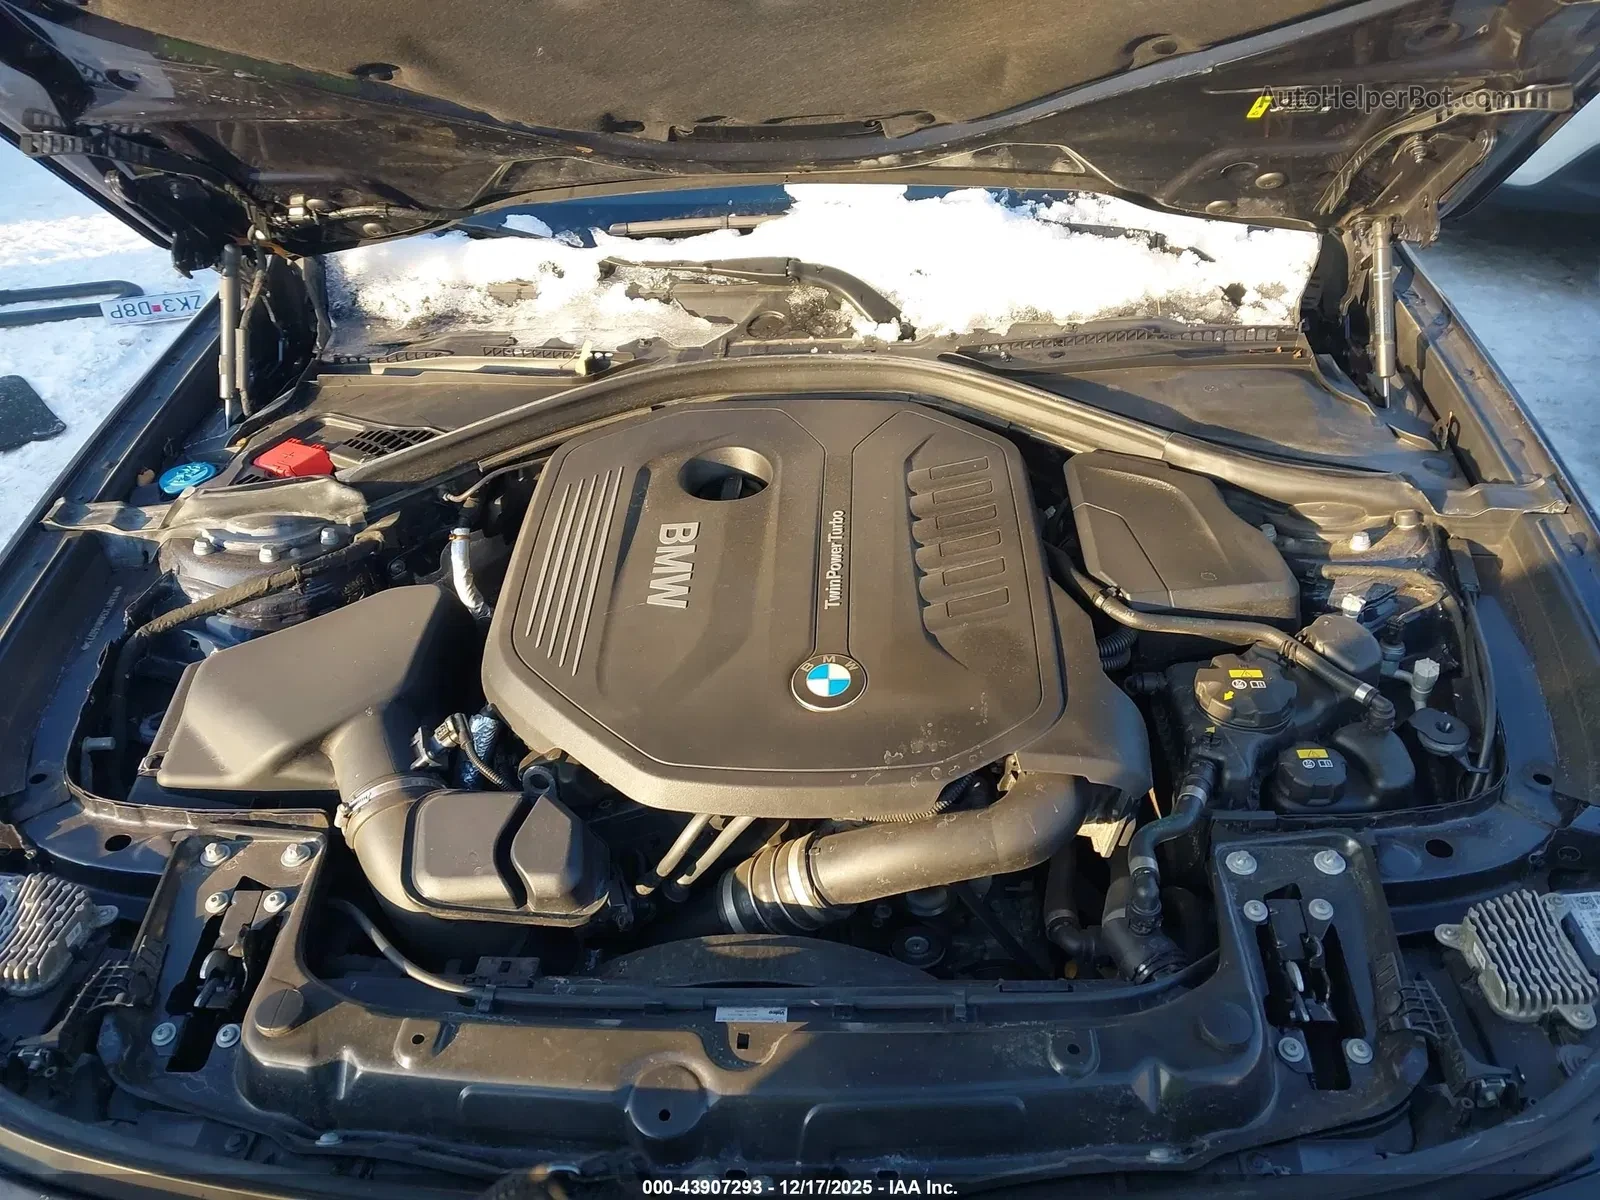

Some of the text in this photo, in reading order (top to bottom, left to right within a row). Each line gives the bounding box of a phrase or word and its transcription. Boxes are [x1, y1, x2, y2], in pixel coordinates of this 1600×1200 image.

[647, 521, 700, 609] BMW
[824, 510, 845, 609] TwinPowerTurbo
[800, 655, 859, 672] BMW
